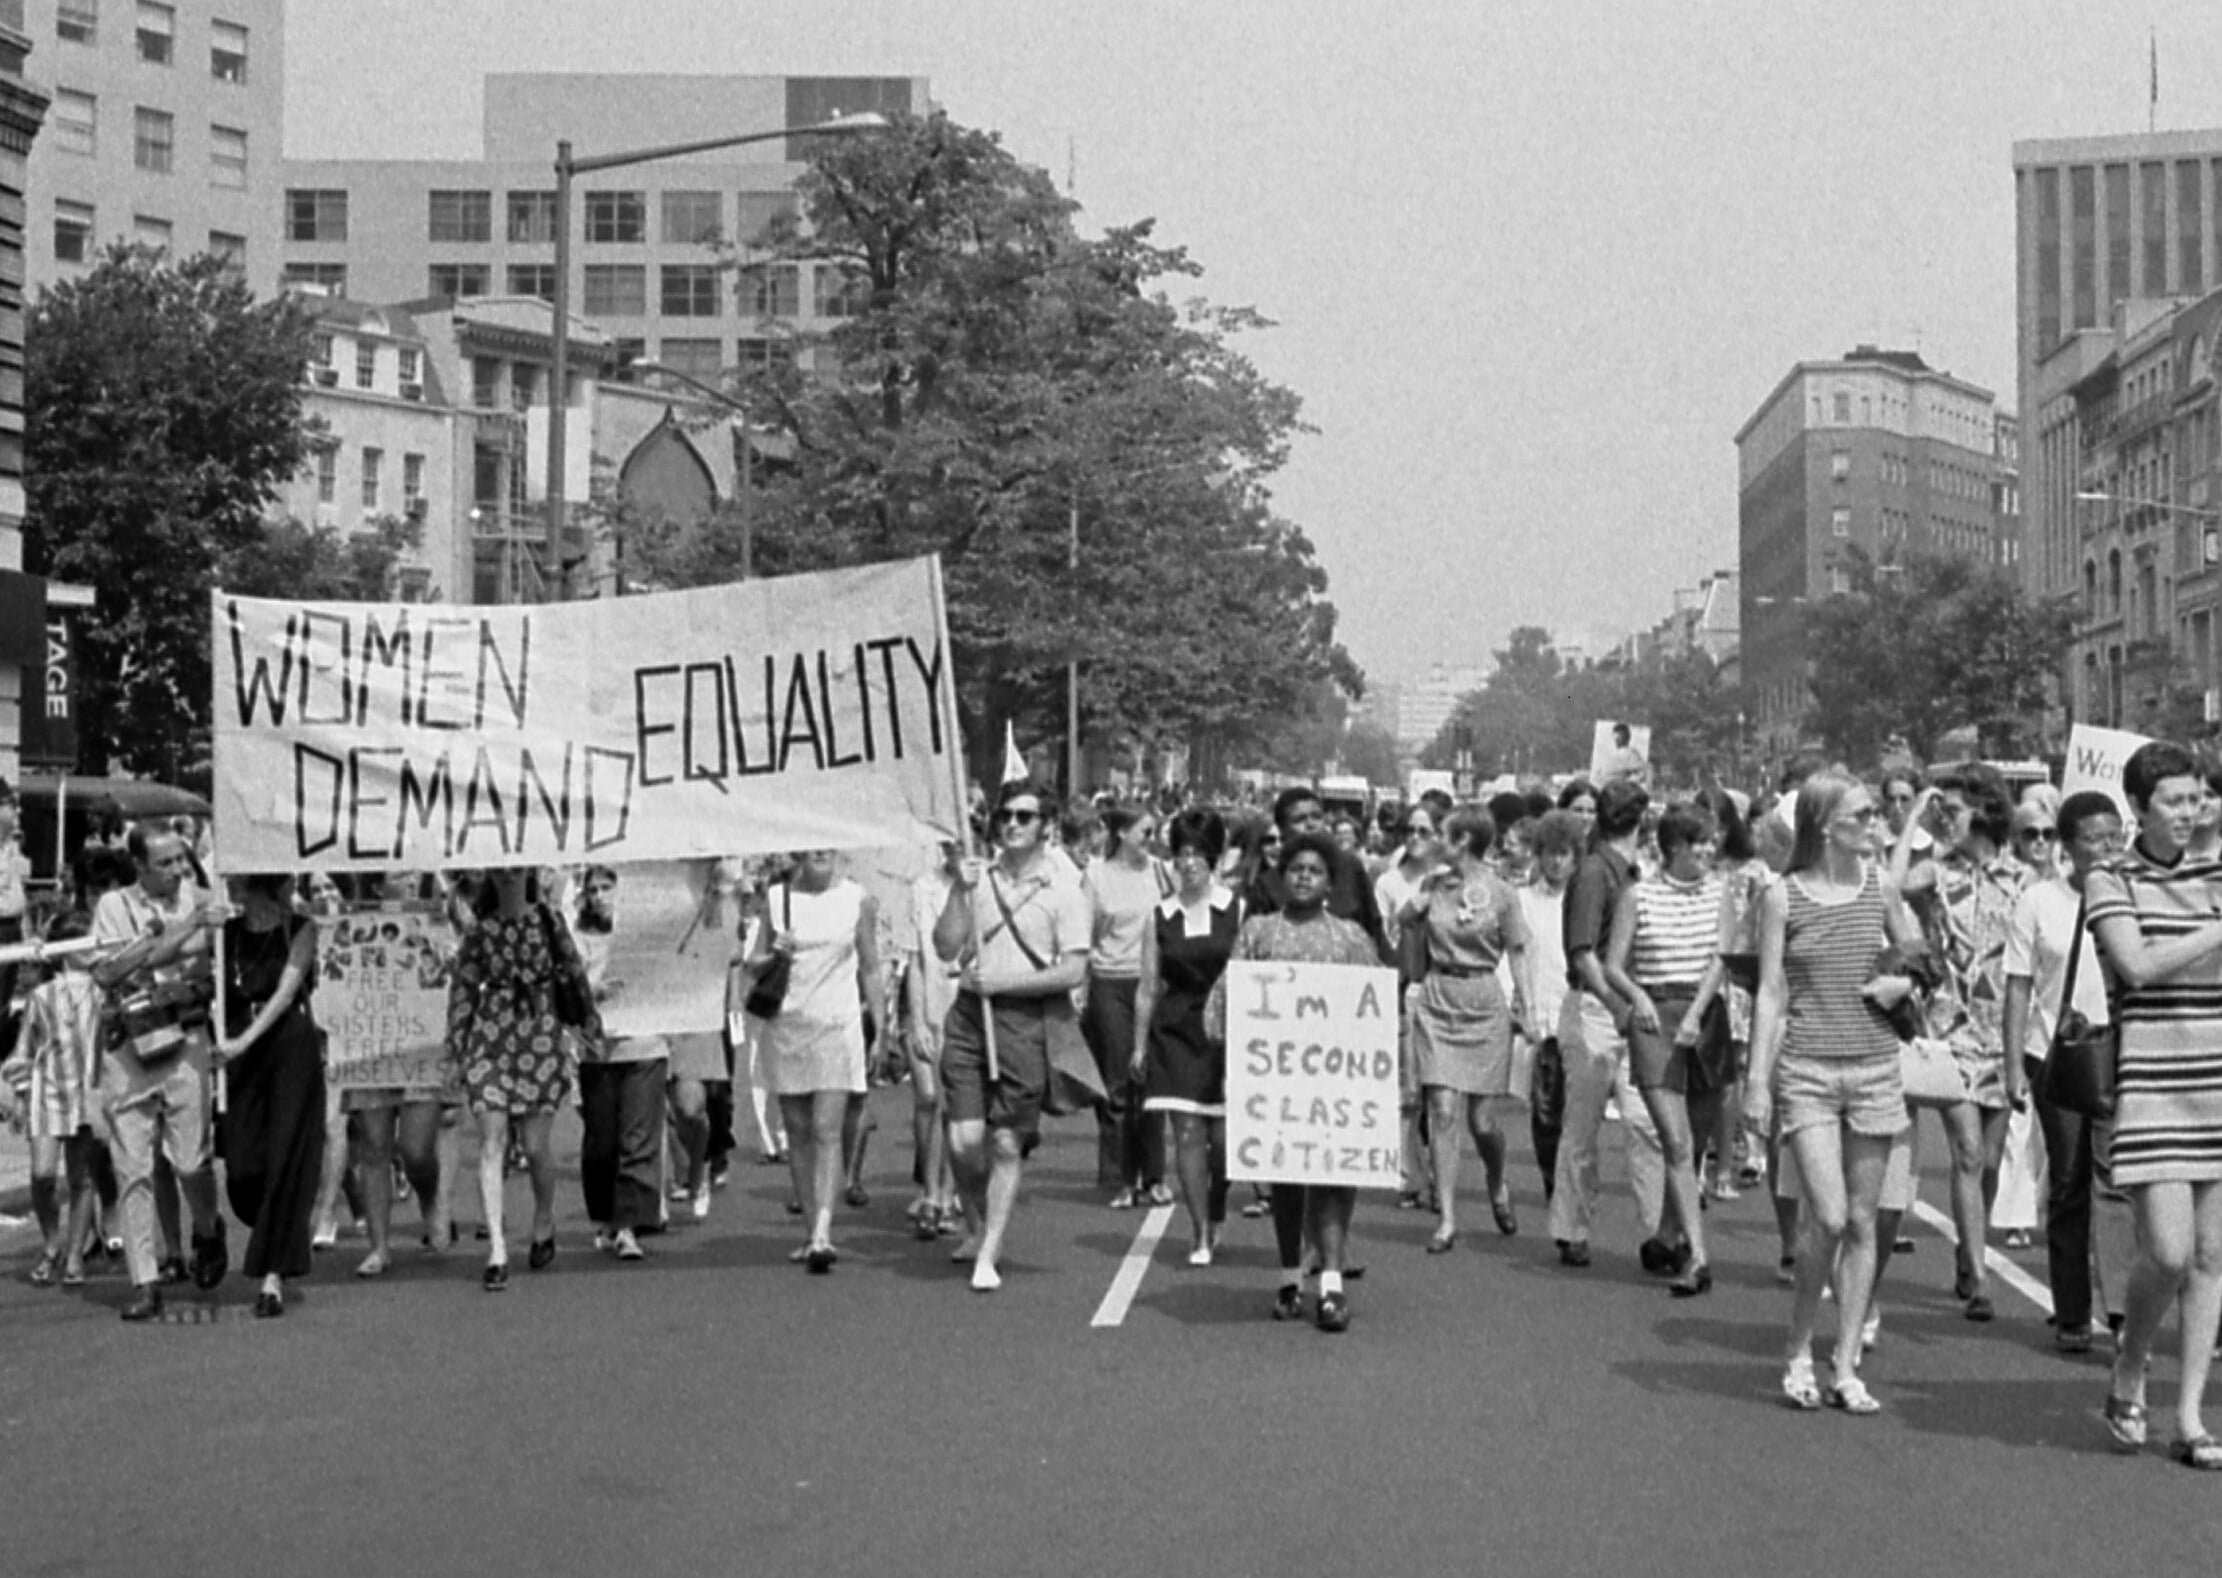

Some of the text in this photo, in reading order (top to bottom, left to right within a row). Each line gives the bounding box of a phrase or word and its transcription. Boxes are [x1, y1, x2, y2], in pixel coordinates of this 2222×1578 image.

[46, 616, 68, 718] TAGE
[228, 601, 529, 729] WOMEN
[635, 637, 943, 794] EQUALITY
[2077, 746, 2123, 783] Wo
[295, 741, 634, 859] DEMAND
[1356, 981, 1381, 1018] A
[328, 1015, 427, 1036] SISTERS
[1246, 1037, 1393, 1080] SECOND
[1245, 1093, 1380, 1129] CLASS
